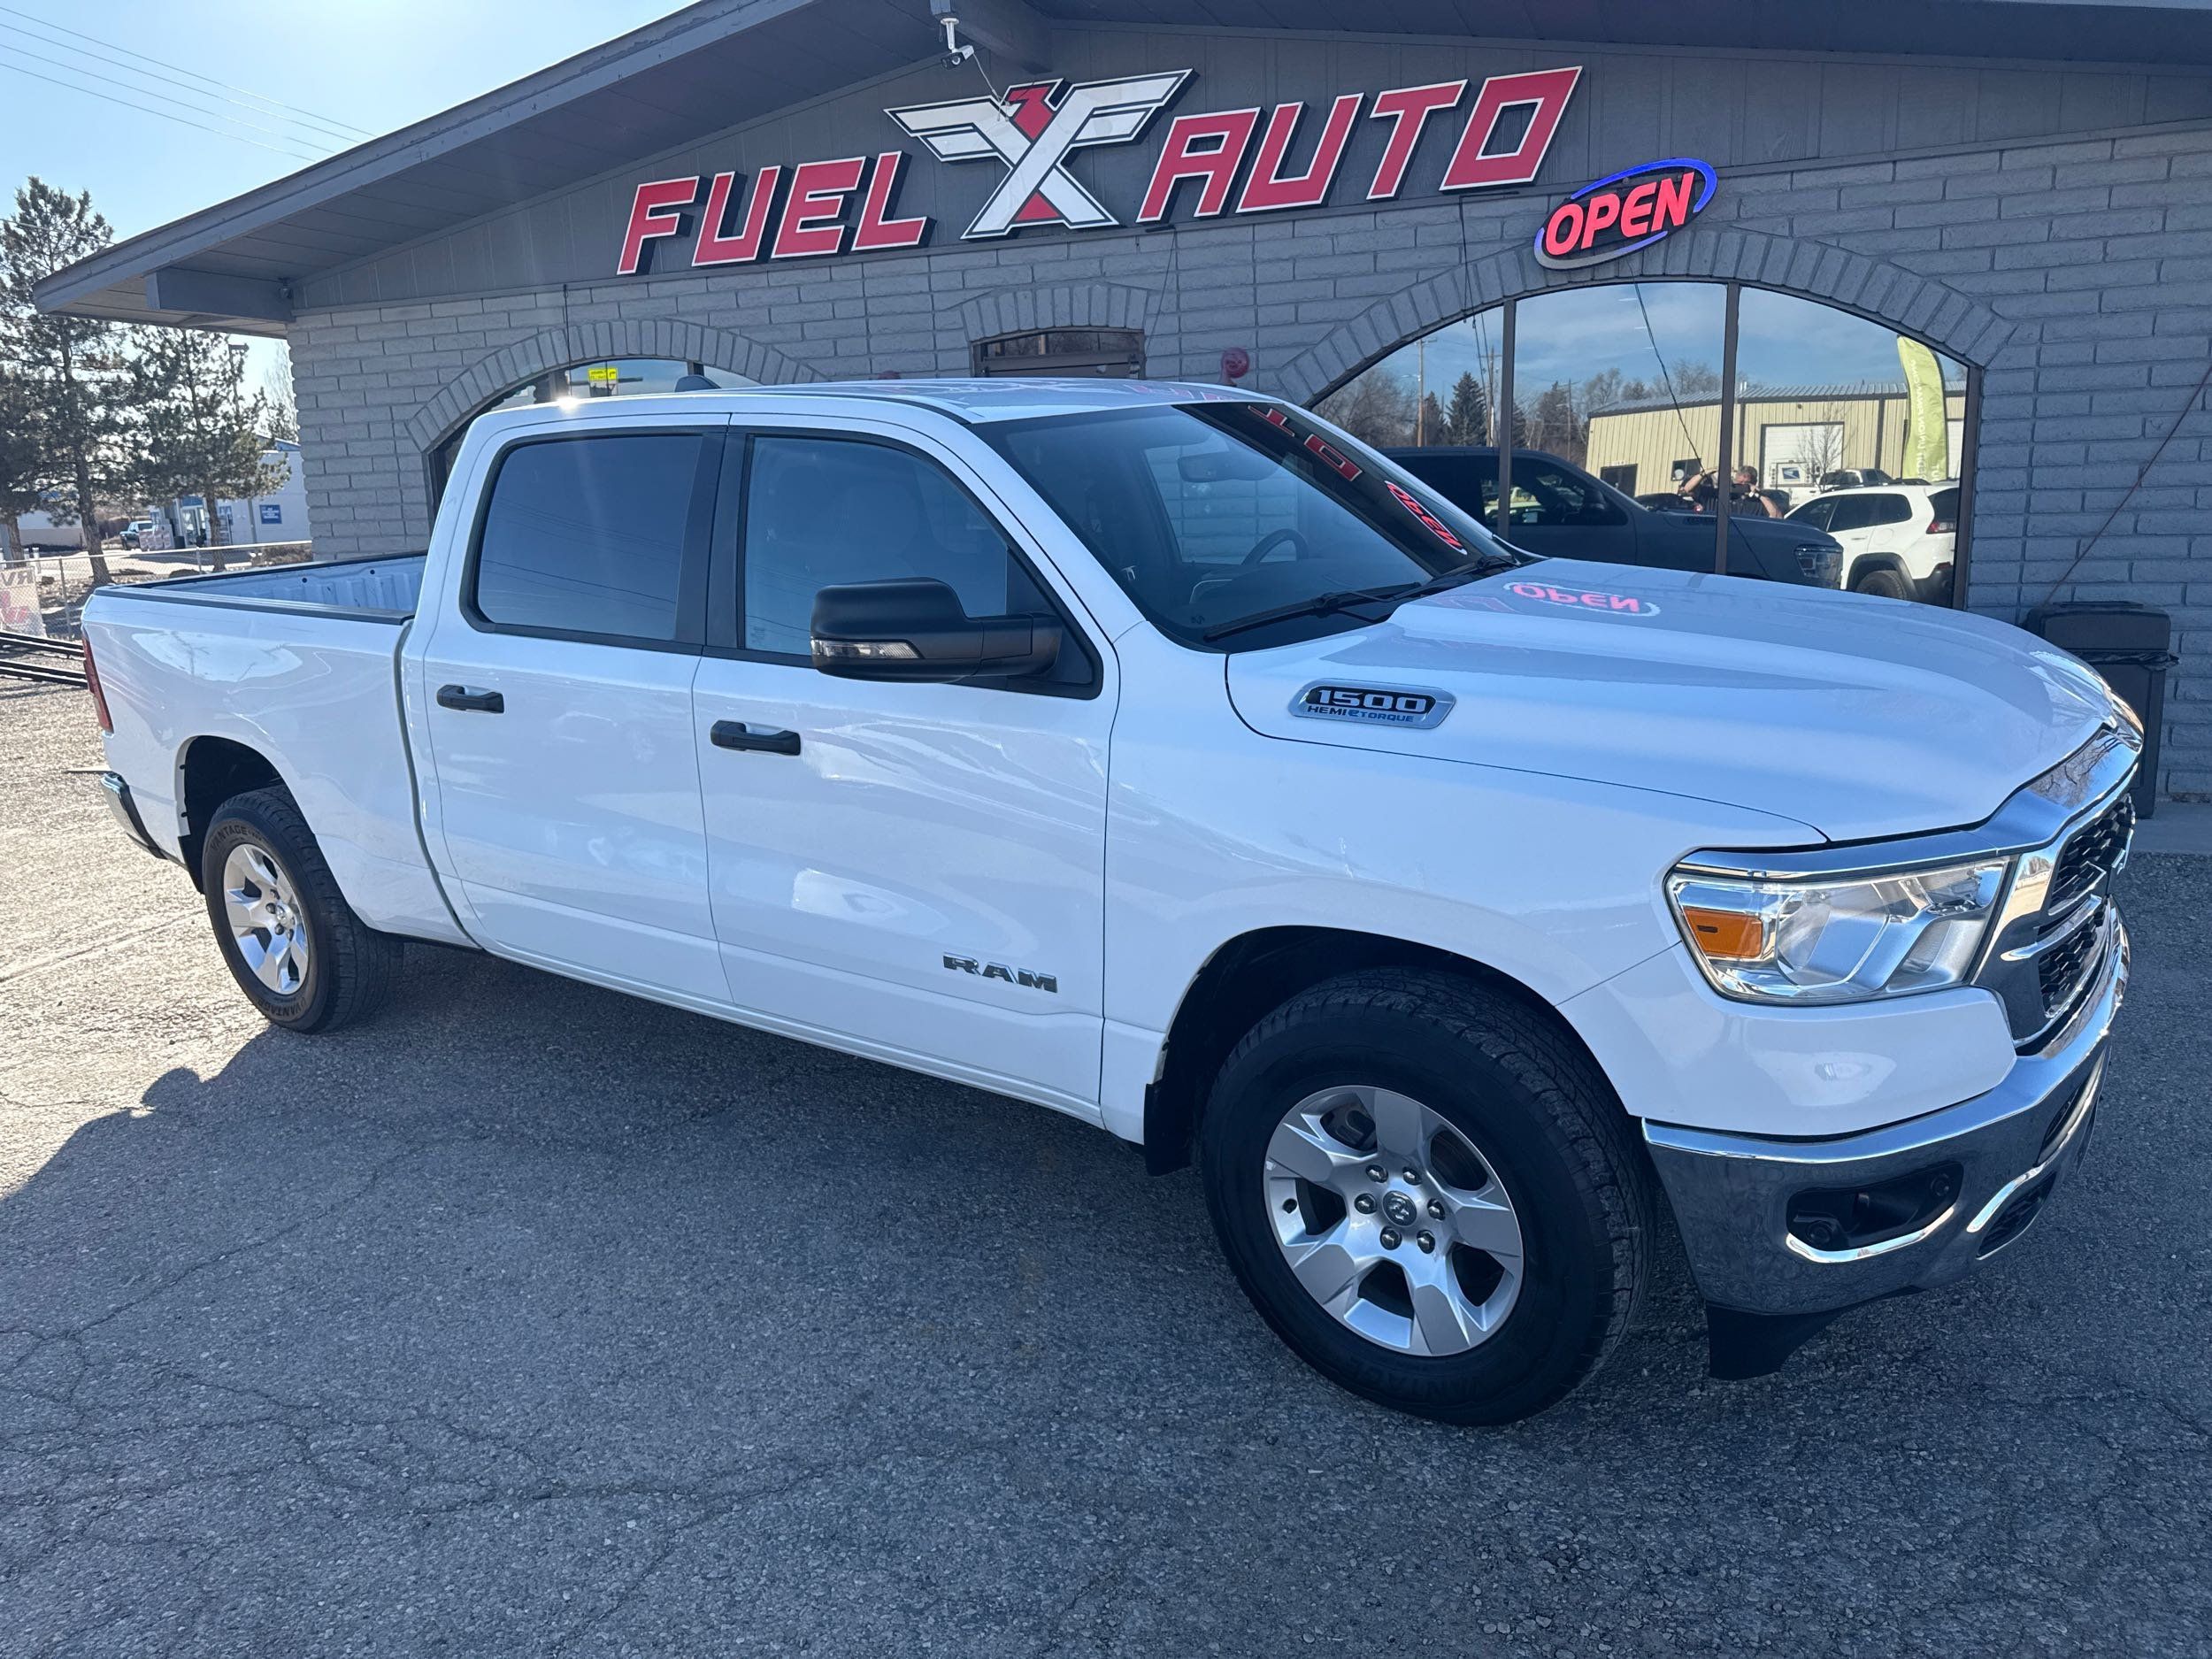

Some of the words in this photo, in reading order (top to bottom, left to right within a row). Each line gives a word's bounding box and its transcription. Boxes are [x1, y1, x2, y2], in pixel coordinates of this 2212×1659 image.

[617, 150, 931, 276] FUEL
[1135, 65, 1584, 224] AUTO
[1544, 172, 1694, 257] OPEN
[1307, 704, 1347, 717] HEMI
[1317, 689, 1427, 713] 1500
[942, 952, 1058, 994] RAM
